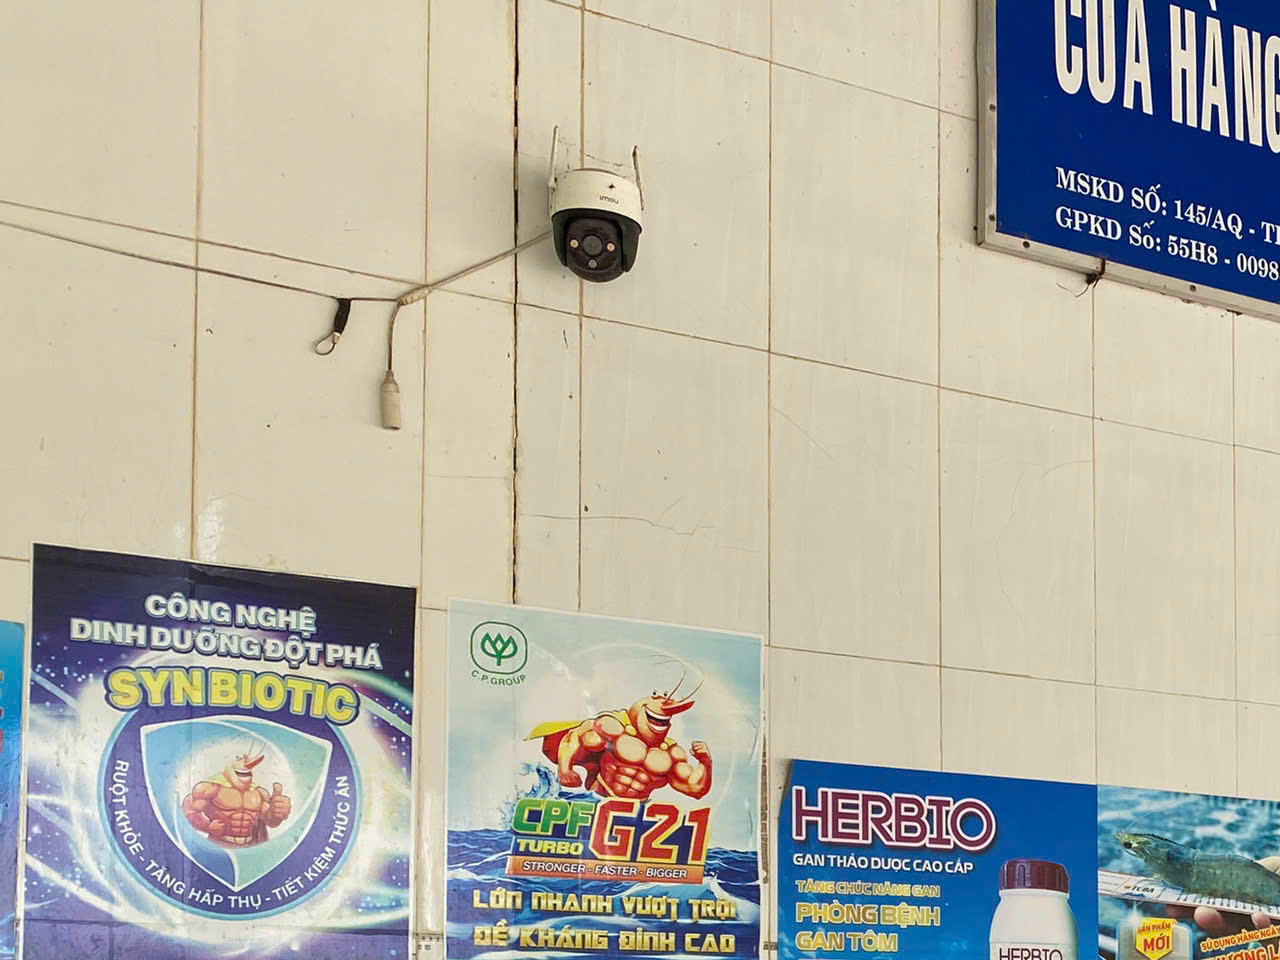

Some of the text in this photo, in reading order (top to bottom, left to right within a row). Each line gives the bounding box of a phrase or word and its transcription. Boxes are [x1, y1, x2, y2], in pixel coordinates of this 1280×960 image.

[1056, 167, 1124, 203] MSKD
[1131, 183, 1167, 216] SỐ:
[1174, 200, 1242, 240] 145/AQ
[1055, 206, 1122, 242] GPKD
[1128, 221, 1161, 252] Số:
[1167, 236, 1218, 266] 55H8
[145, 592, 317, 637] CÔNG NGHỆ
[70, 618, 383, 670] DINH DƯỠNG ĐỘT PHÁ
[110, 760, 129, 804] RUỘT
[511, 798, 712, 864] CPF G21
[792, 785, 996, 851] HERBIO
[515, 839, 584, 856] TURBO
[793, 853, 974, 875] GAN THẢO DƯỢC CAO CẤP
[523, 860, 688, 879] STRONGER FASTER BIGGER
[473, 888, 612, 913] LỚN NHANH
[795, 899, 940, 928] PHÒNG BỆNH
[519, 925, 736, 953] KHÁNG CAO
[795, 929, 898, 952] GAN TÔM
